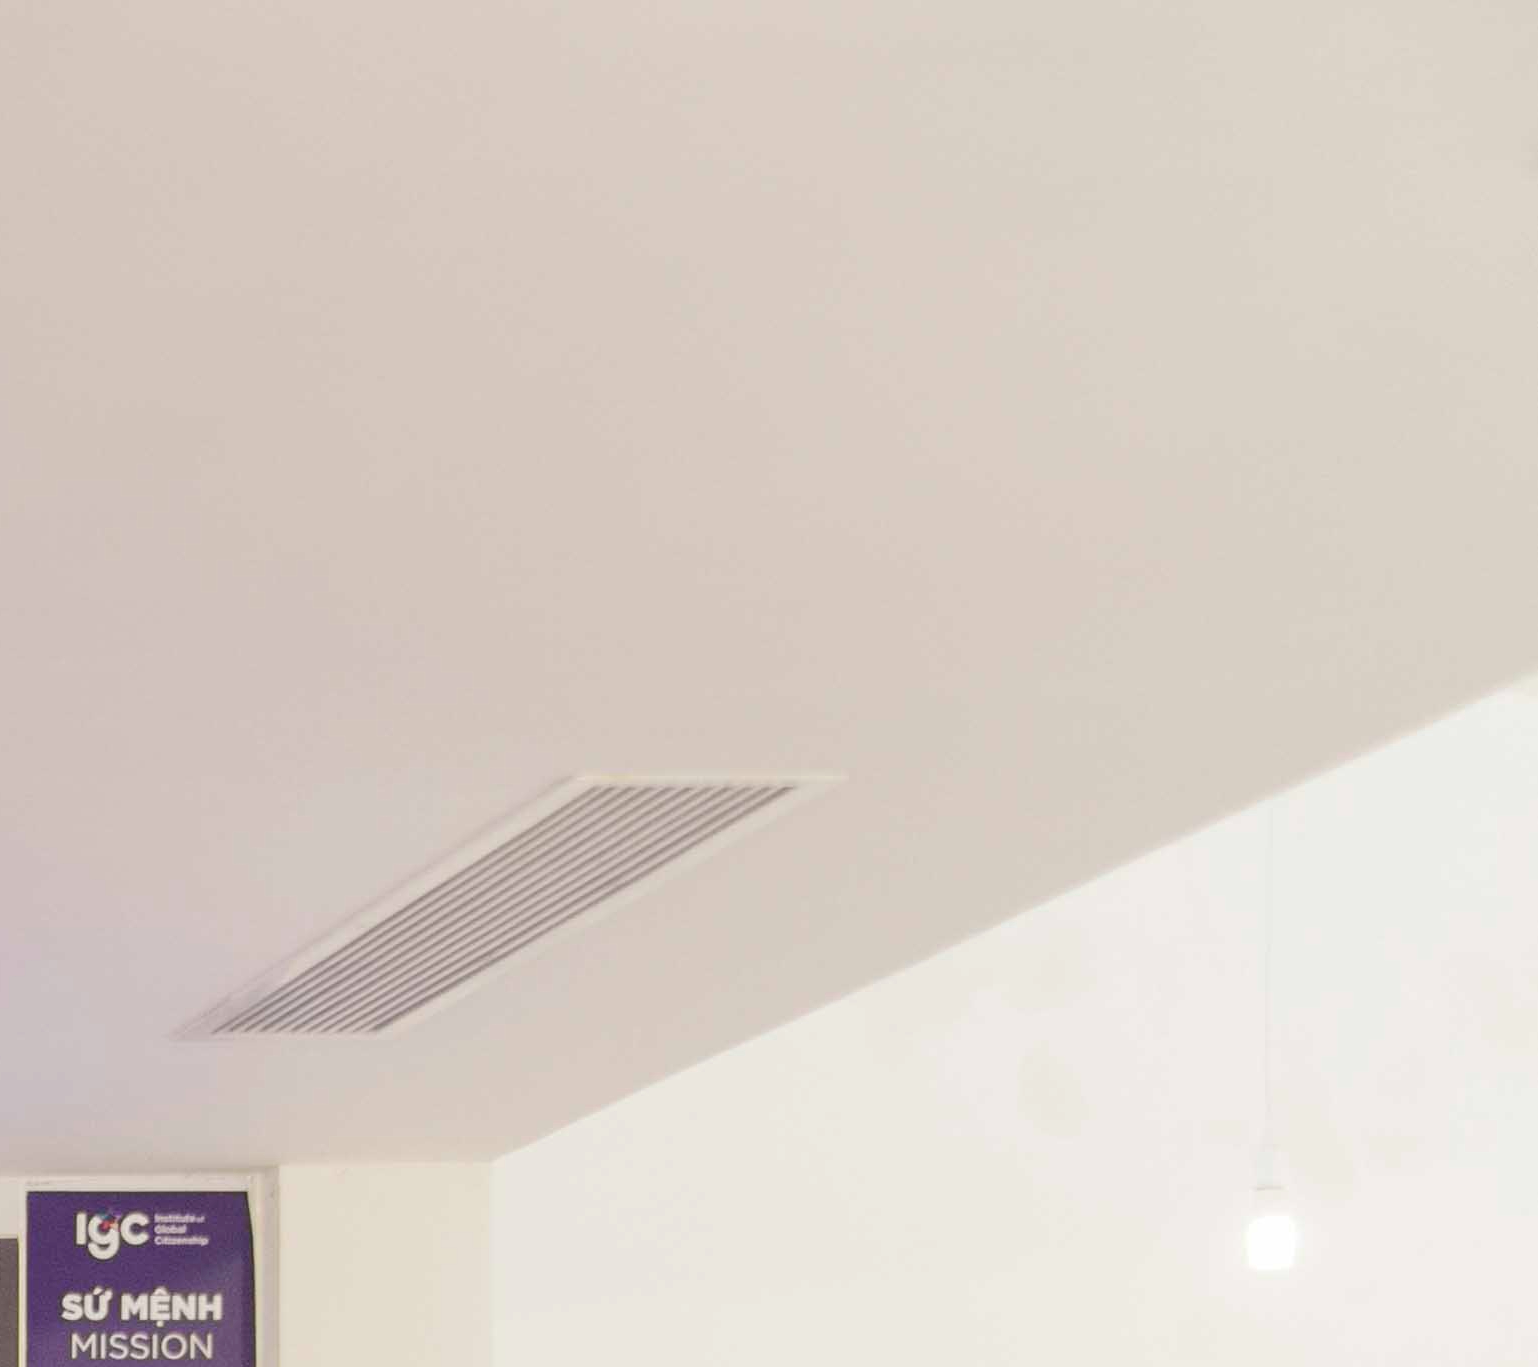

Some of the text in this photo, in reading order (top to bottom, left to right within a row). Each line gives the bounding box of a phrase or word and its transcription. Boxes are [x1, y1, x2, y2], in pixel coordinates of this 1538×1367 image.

[61, 1286, 223, 1327] SỨ MỆNH
[71, 1332, 213, 1360] MISSION
